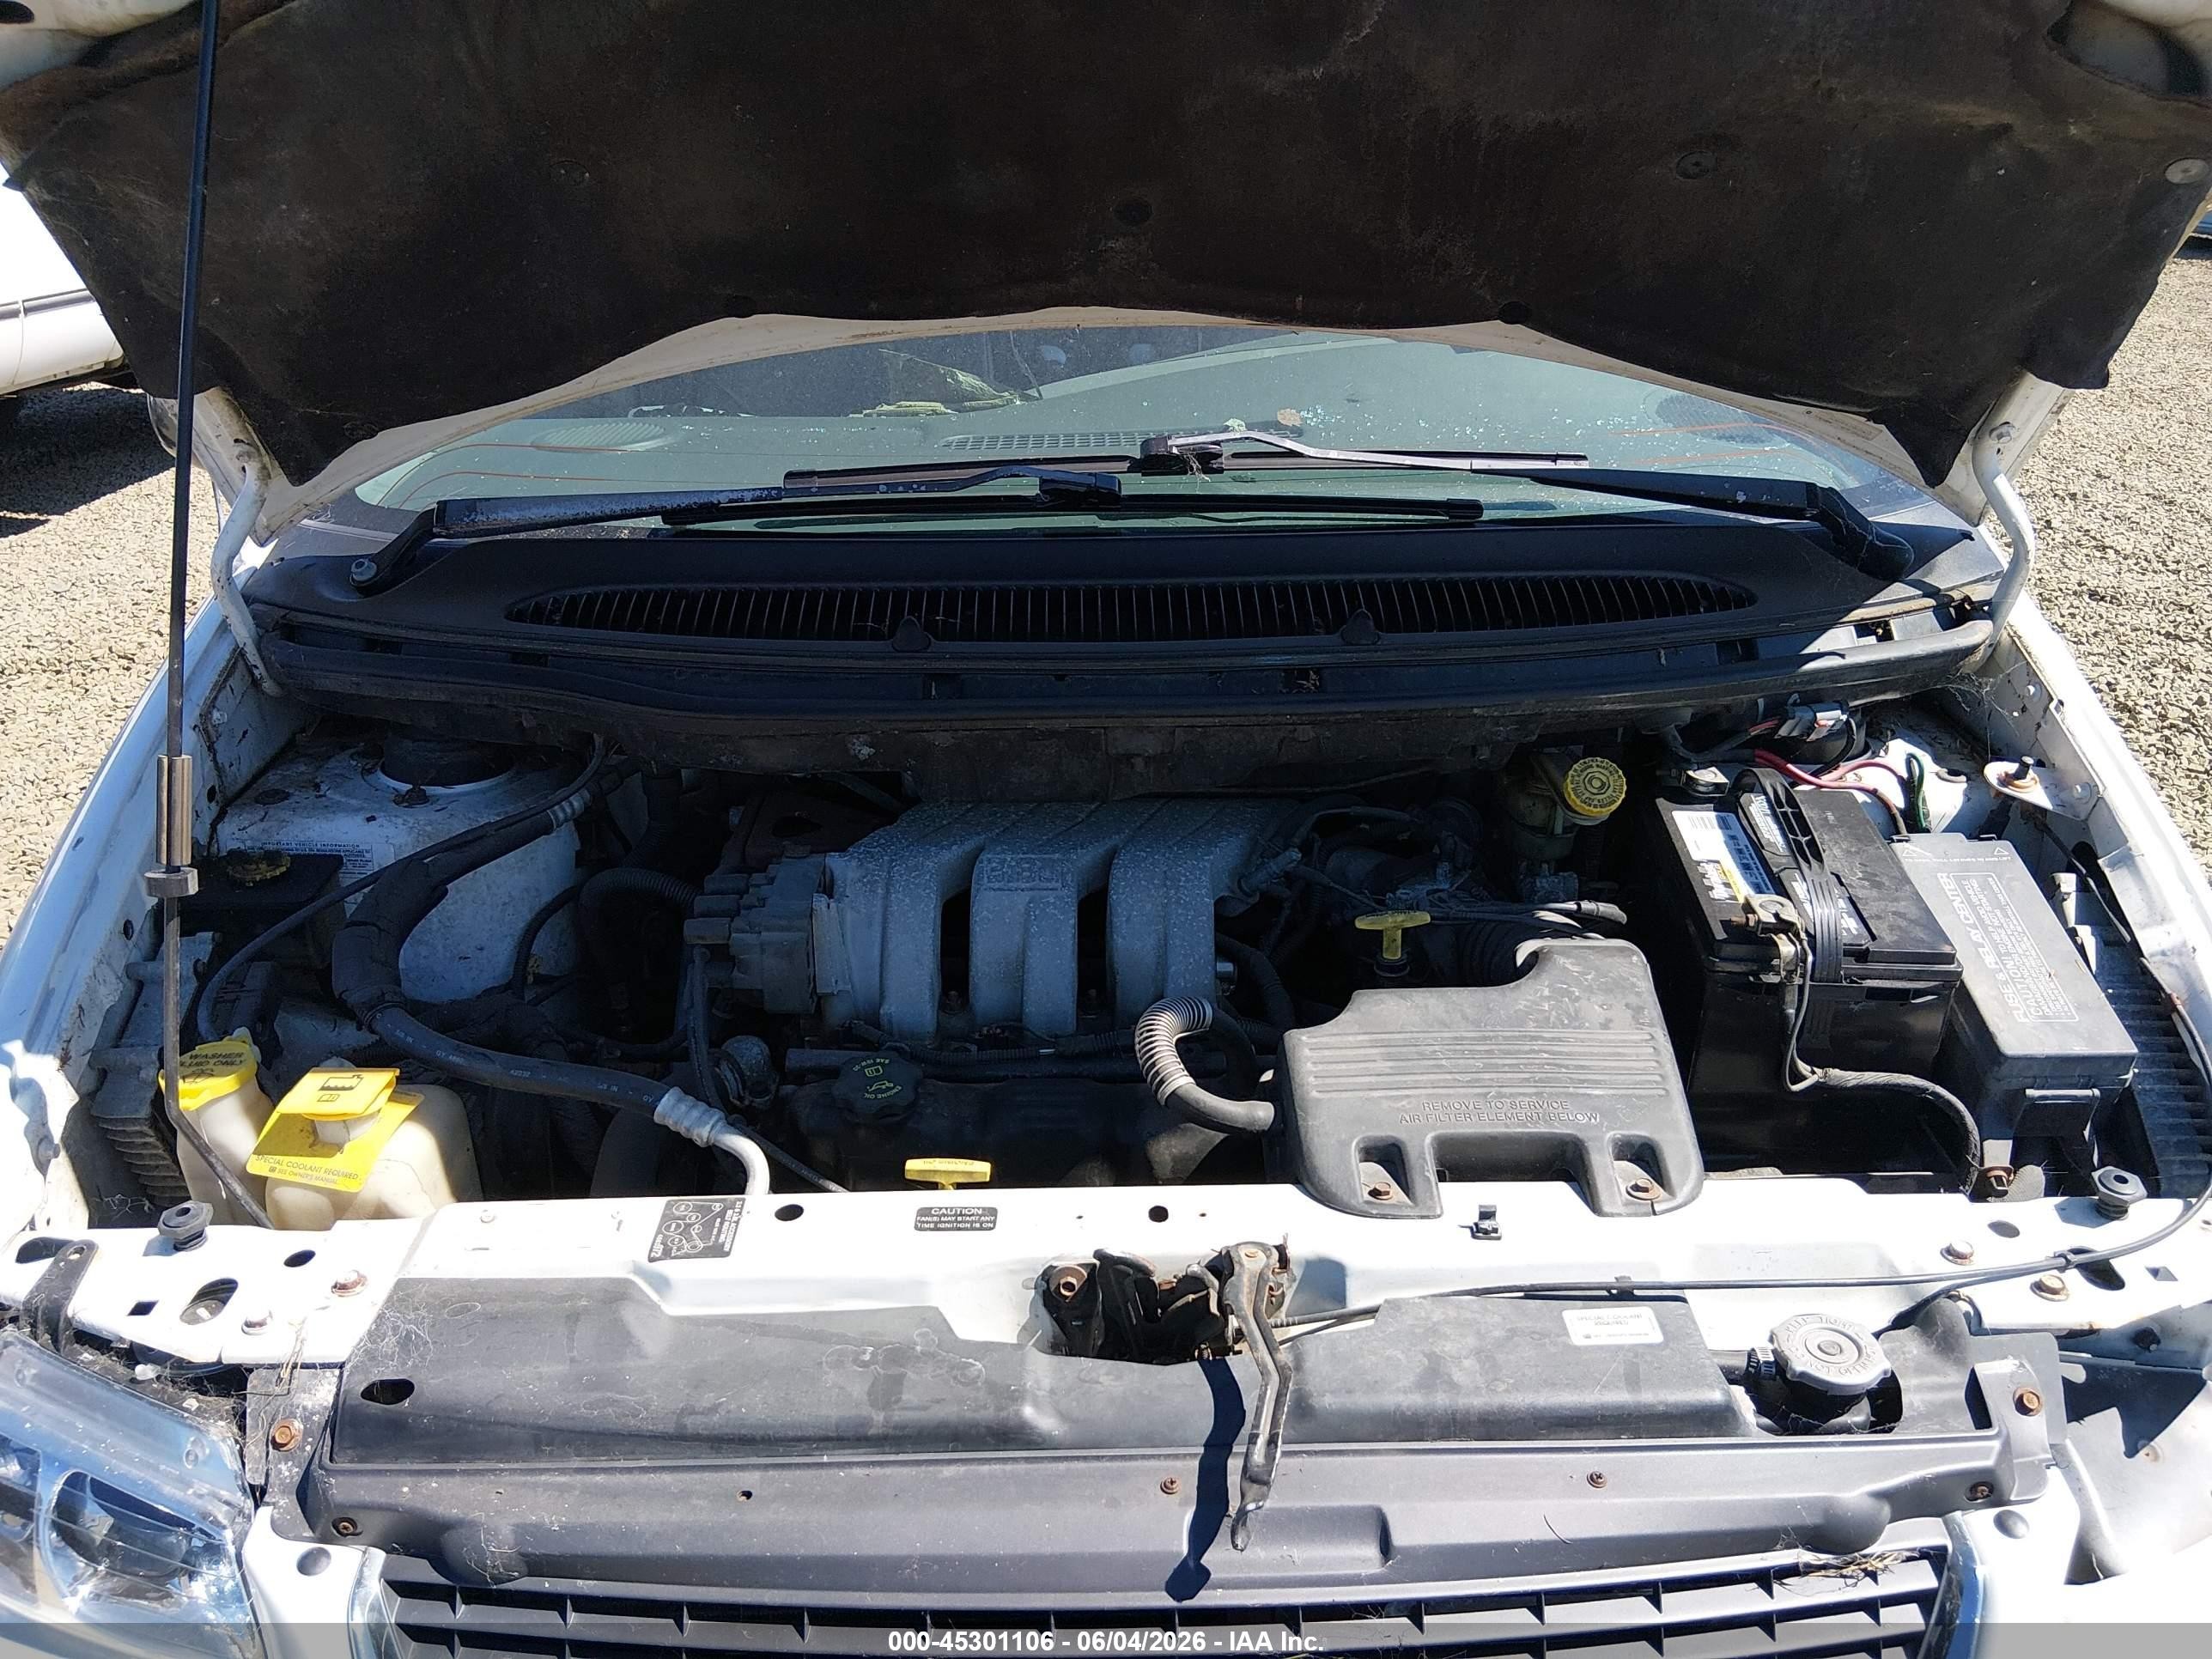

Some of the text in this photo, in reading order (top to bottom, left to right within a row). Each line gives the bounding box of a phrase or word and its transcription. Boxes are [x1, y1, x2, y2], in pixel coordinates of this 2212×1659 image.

[1936, 872, 1975, 923] CENTER
[1967, 878, 1994, 911] STARTING
[1987, 913, 2002, 925] NOT
[1960, 878, 2044, 1015] CAUTION! TO HELP AVOID VEHICLE
[1966, 927, 2000, 968] RELAY
[1995, 927, 2017, 952] ENGINE
[2010, 953, 2034, 982] AND/OR
[1996, 983, 2030, 1022] FUSE
[2027, 983, 2053, 1015] DAMAGE
[877, 1085, 902, 1099] ENGINE
[1422, 1100, 1571, 1111] REMOVE TO SERVICE
[1399, 1112, 1601, 1124] AIR FILTER ELEMENT BELOW
[255, 1154, 360, 1181] SPECIAL COOLANT REQUIRED
[718, 1209, 733, 1243] BELT ROUTING
[722, 1222, 737, 1251] ACCESSORY
